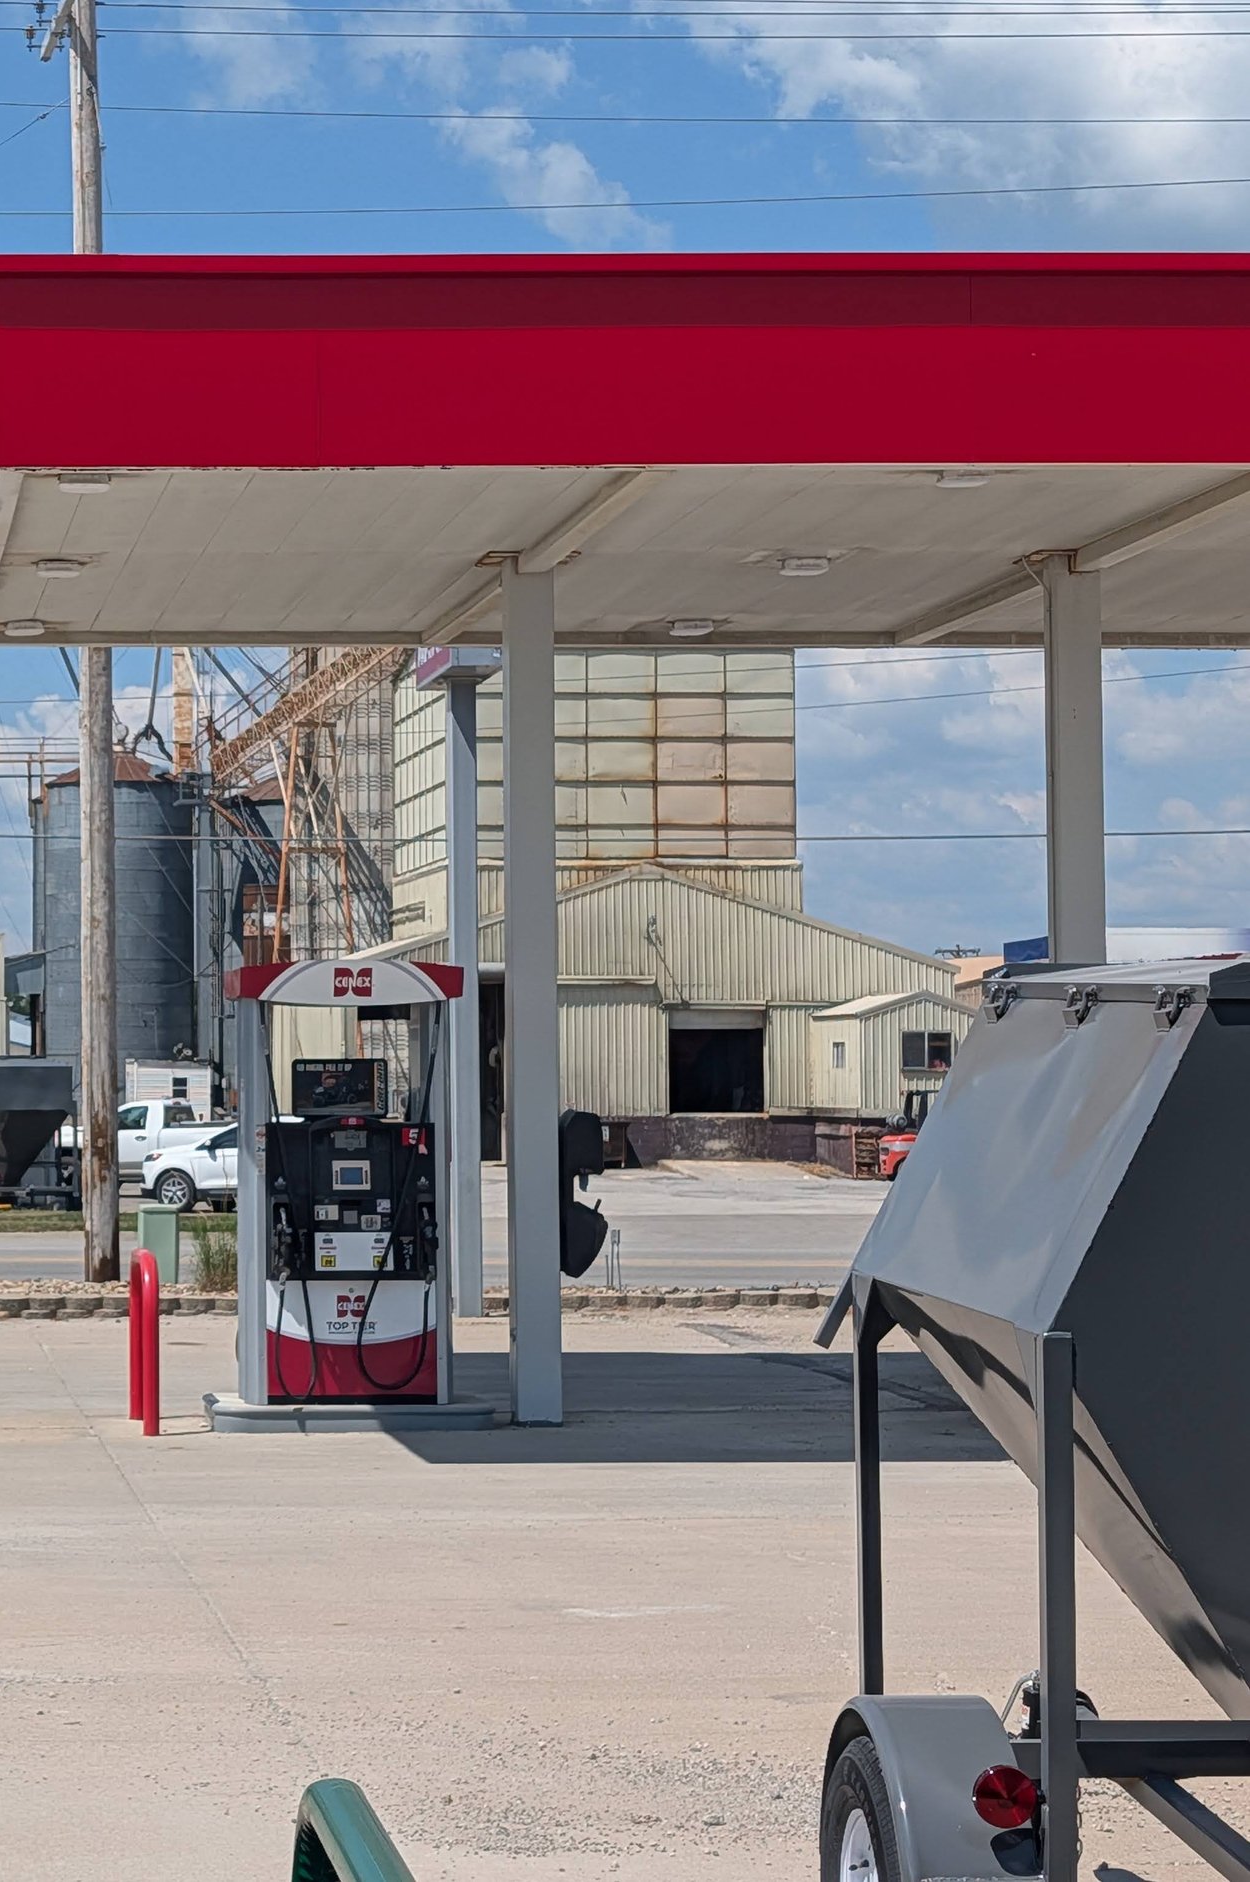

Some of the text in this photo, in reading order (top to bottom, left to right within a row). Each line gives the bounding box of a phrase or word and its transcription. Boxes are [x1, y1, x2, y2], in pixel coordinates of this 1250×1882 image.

[334, 976, 371, 988] CENEX
[408, 1128, 419, 1144] 5
[326, 1321, 375, 1331] TOP TR
